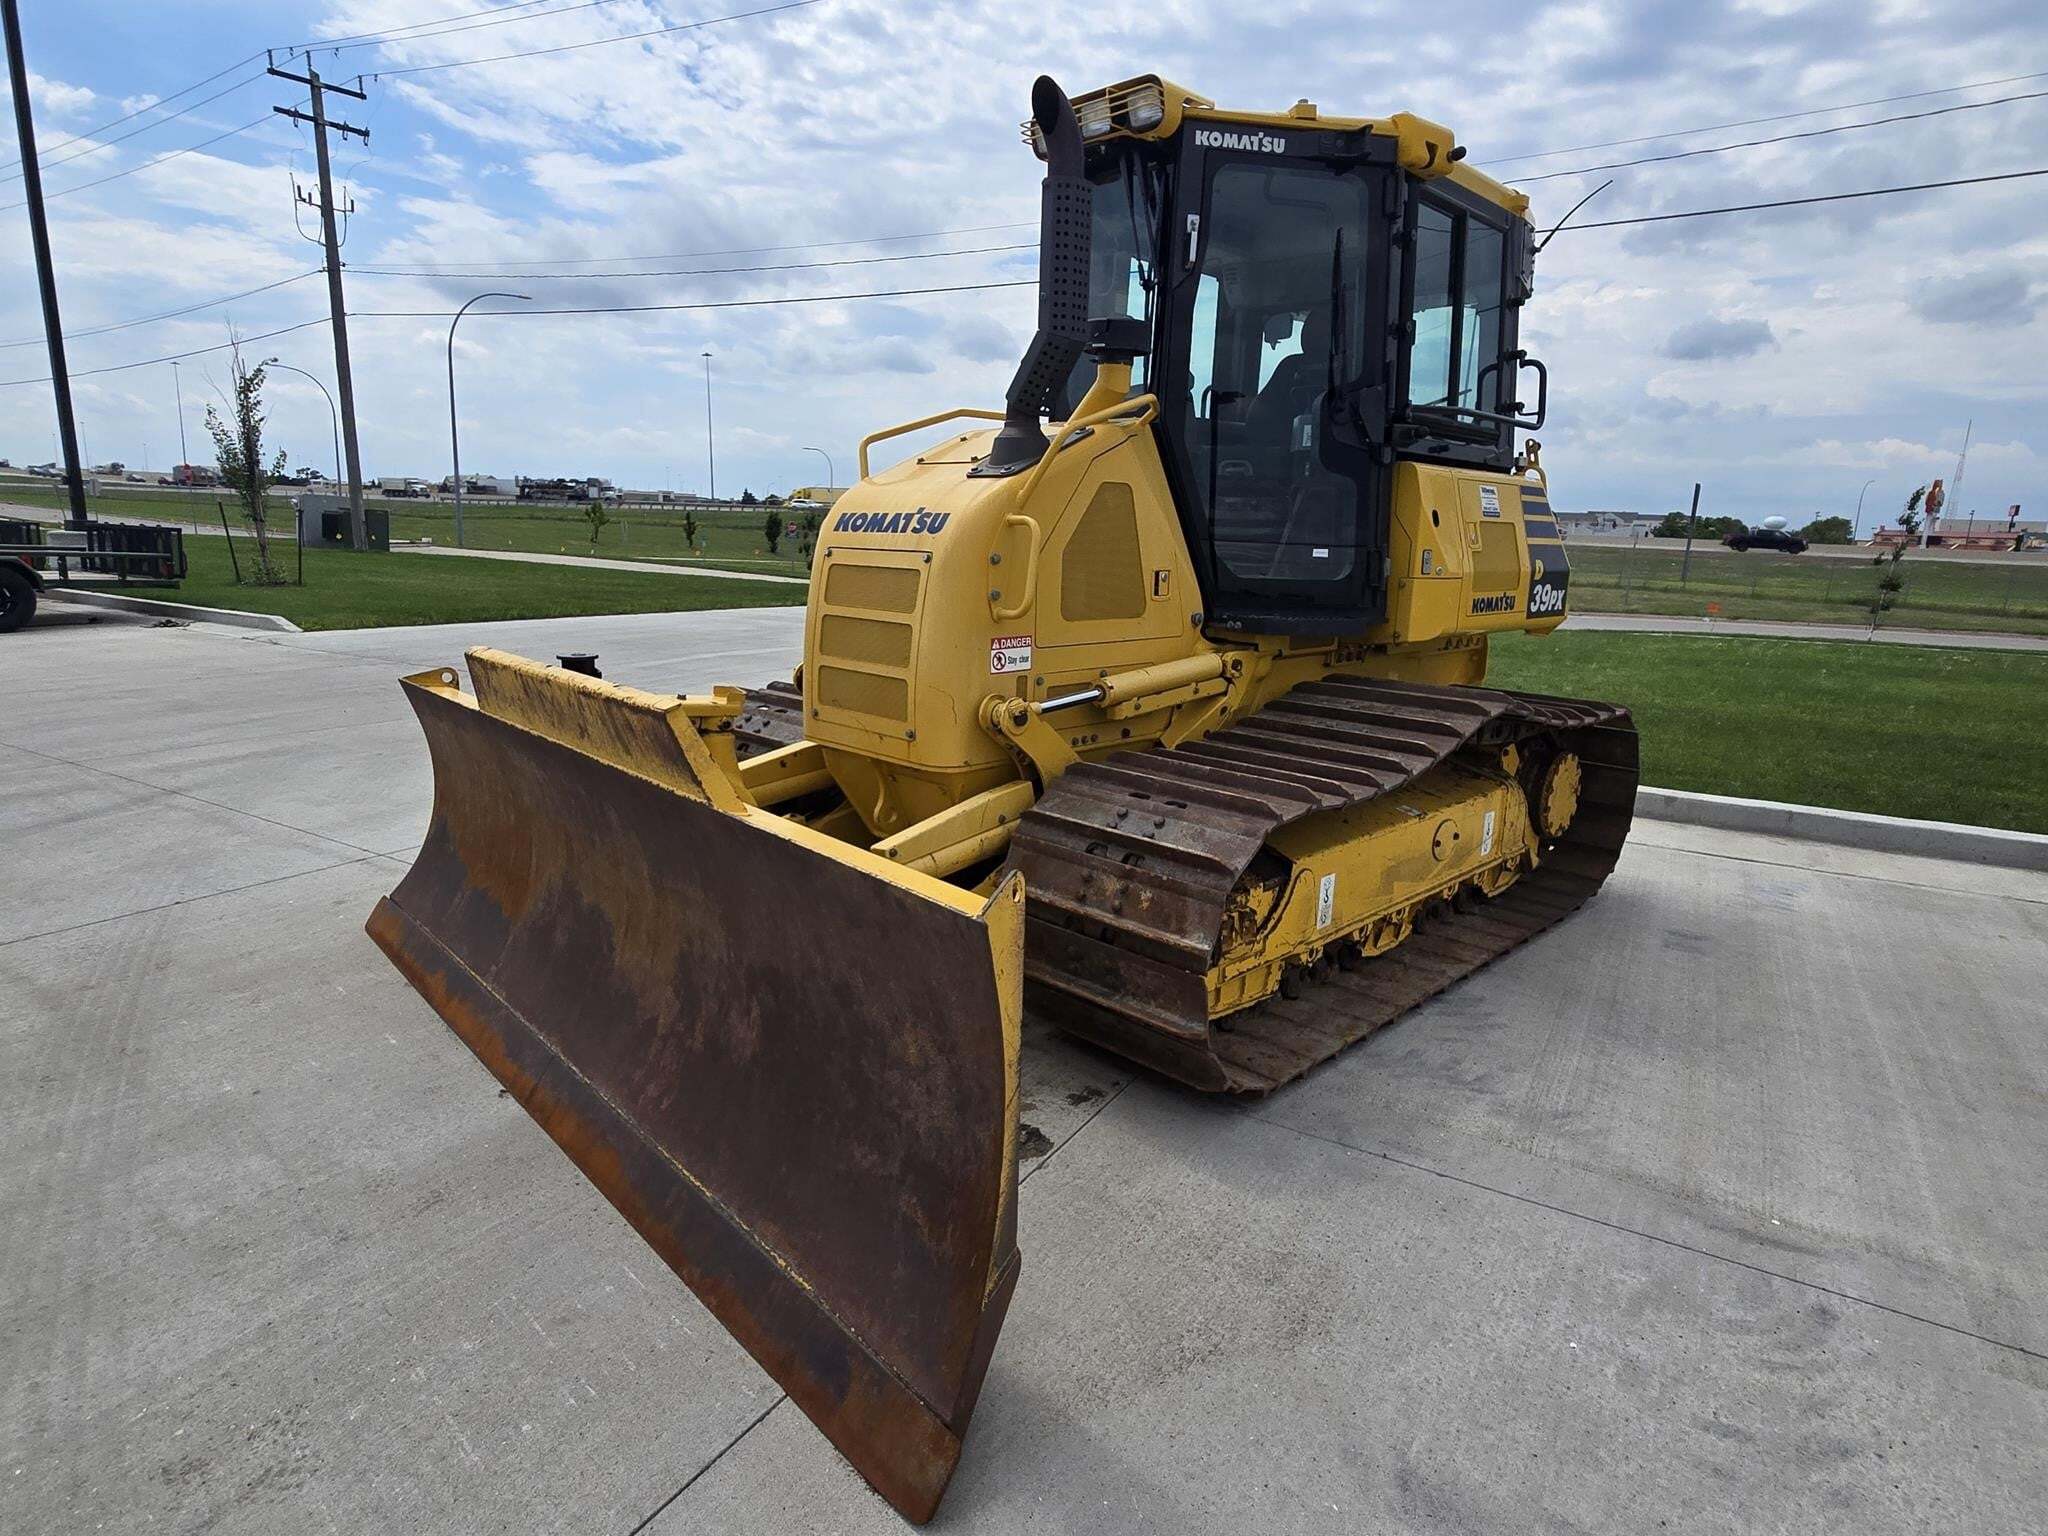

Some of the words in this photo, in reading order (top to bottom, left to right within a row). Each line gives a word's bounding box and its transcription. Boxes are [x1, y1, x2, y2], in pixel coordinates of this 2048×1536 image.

[1195, 130, 1286, 154] KOMATSU
[833, 507, 951, 534] KOMATSU
[1534, 559, 1544, 580] D
[1472, 592, 1516, 613] KOMATSU
[1530, 583, 1565, 612] 39PX
[1000, 637, 1032, 649] DANGER
